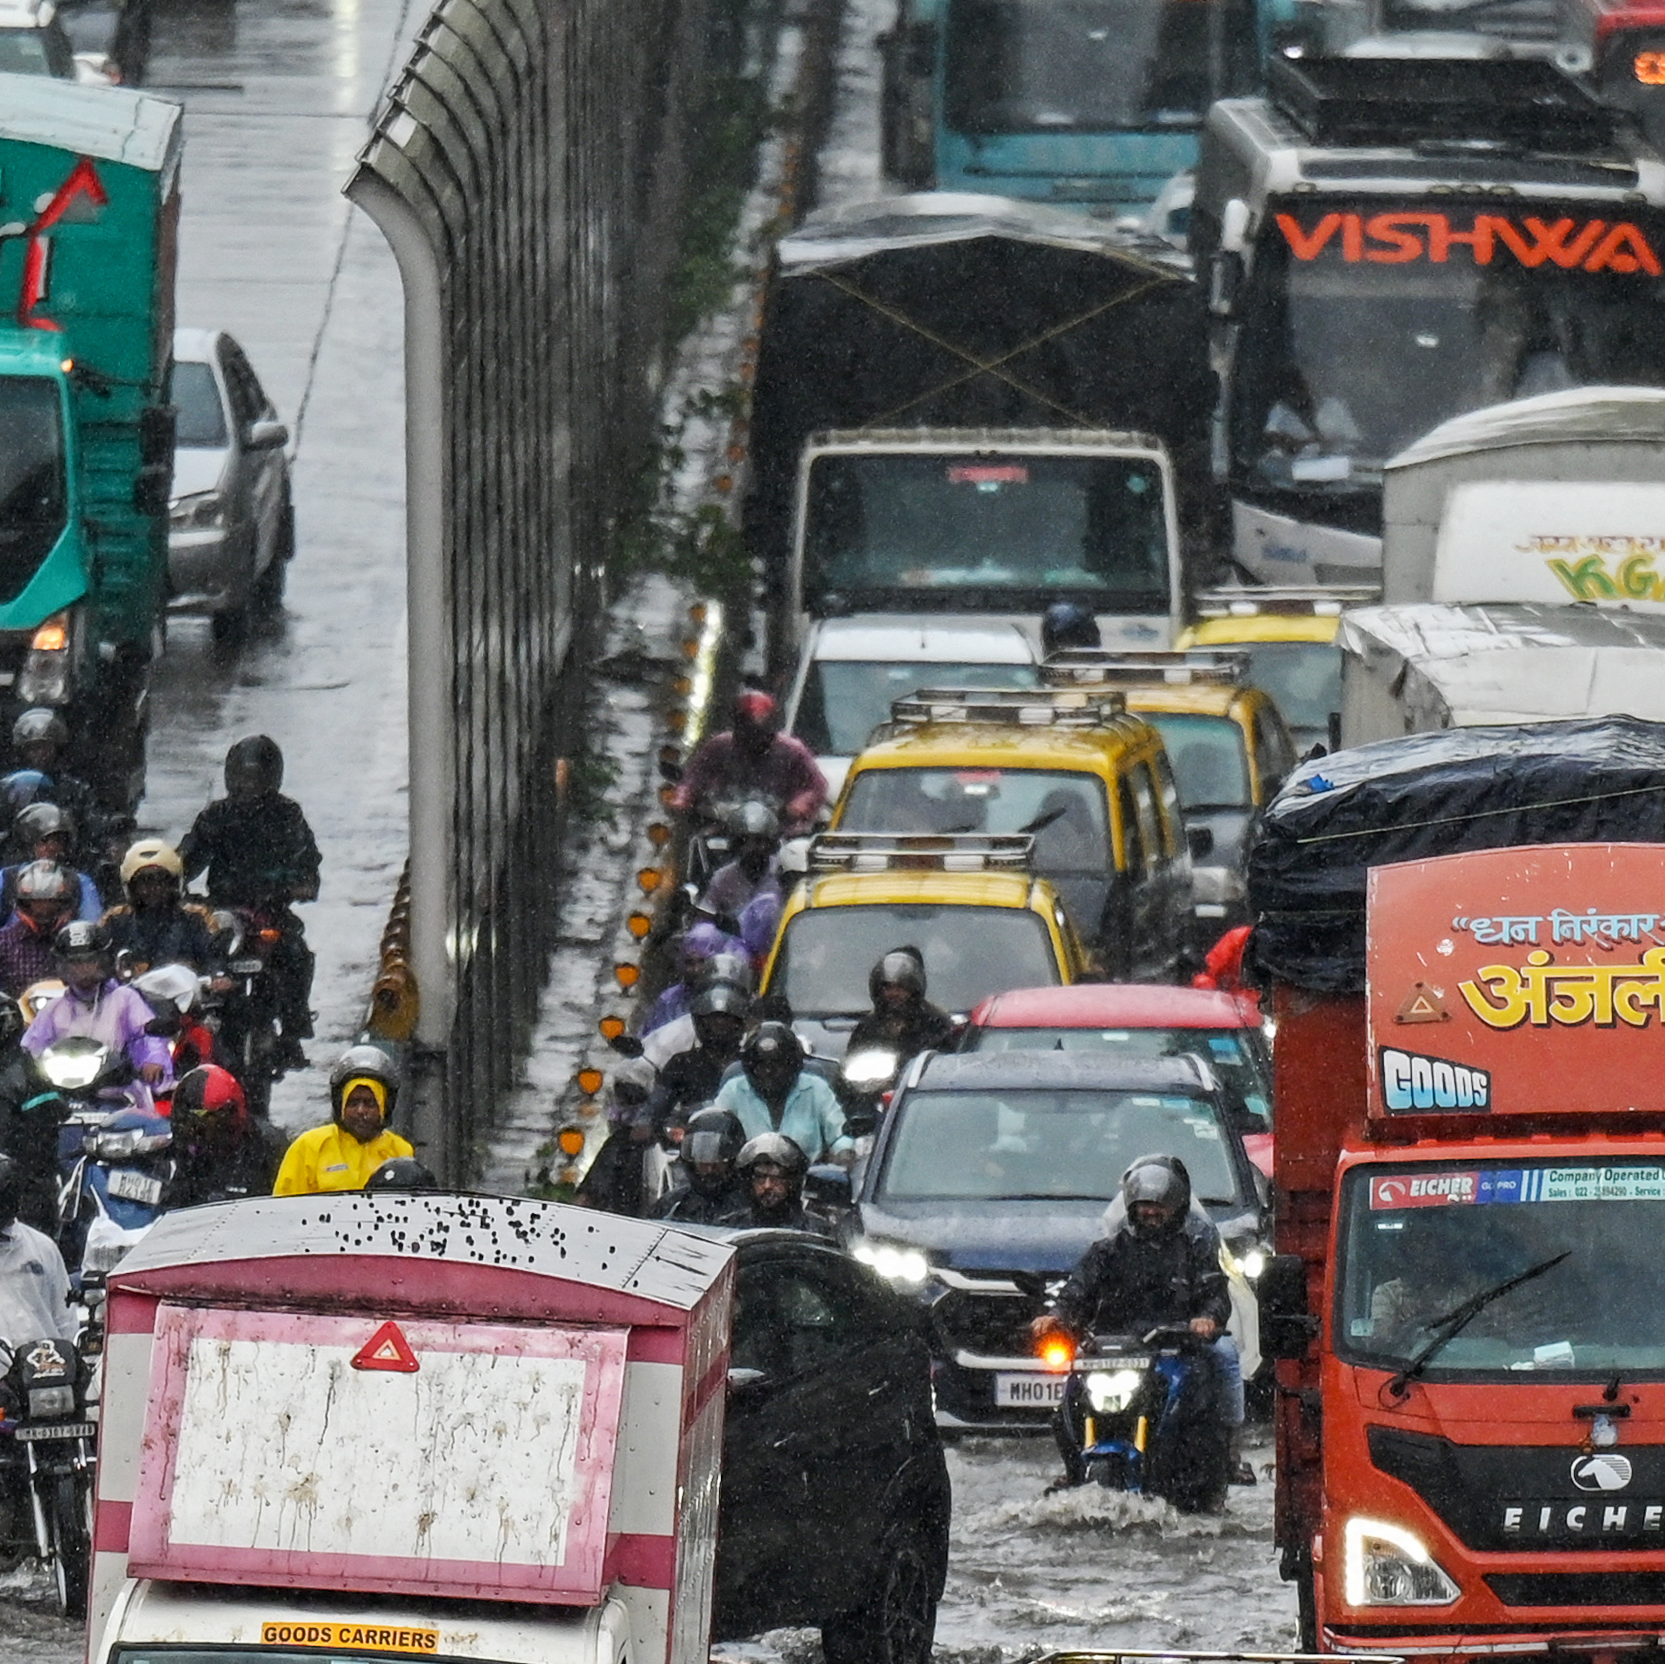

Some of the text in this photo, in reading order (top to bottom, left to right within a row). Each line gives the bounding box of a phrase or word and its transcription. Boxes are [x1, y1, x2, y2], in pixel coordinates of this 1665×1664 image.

[1274, 211, 1663, 277] VISHWA
[1383, 1050, 1489, 1110] GOODS
[1409, 1177, 1473, 1197] EICHER
[1496, 1180, 1517, 1190] PRO
[1549, 1170, 1601, 1185] Company
[1604, 1169, 1660, 1182] Operated
[264, 1626, 436, 1649] GOODS CARRIERS
